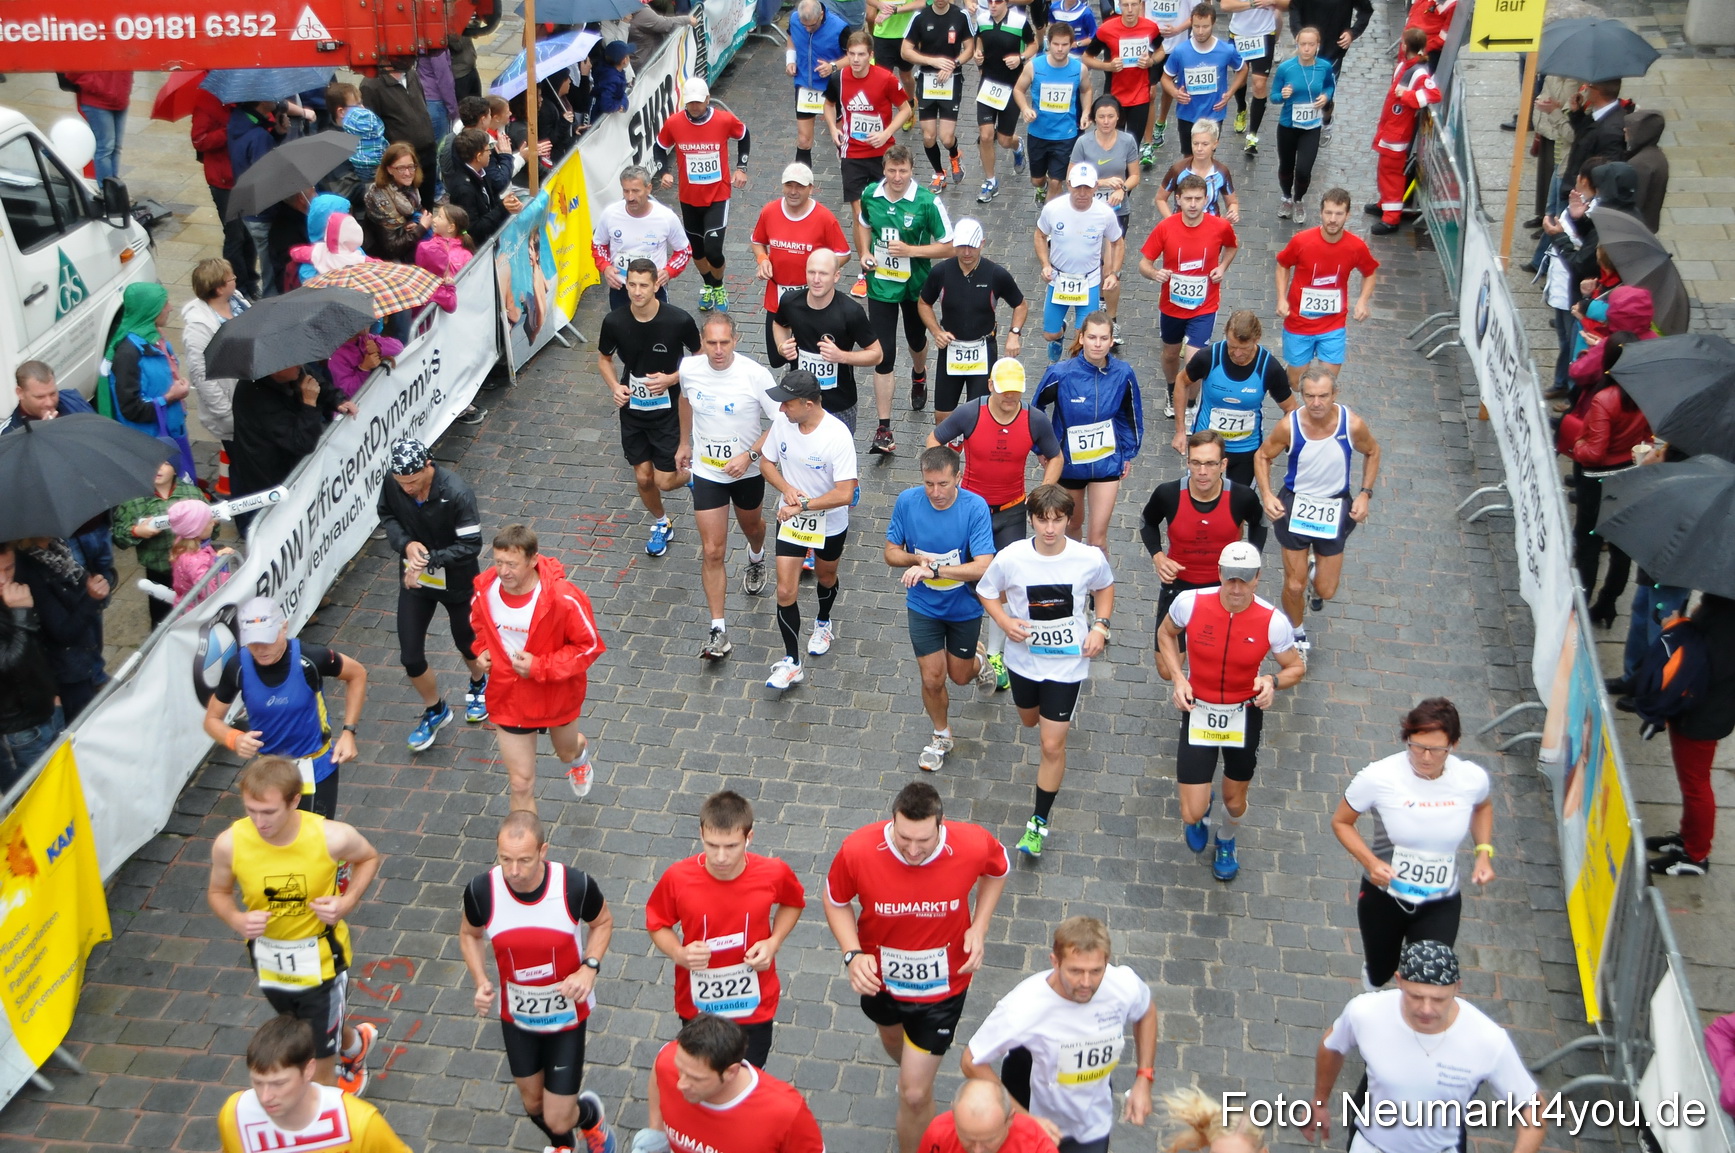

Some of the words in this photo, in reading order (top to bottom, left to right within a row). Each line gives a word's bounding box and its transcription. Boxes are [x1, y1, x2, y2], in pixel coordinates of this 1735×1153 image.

[1154, 1, 1175, 12] 2461
[115, 16, 196, 40] 09181
[206, 15, 276, 37] 6352
[1238, 39, 1260, 52] 2641
[1188, 73, 1214, 84] 2430
[808, 92, 819, 102] 21
[990, 86, 1002, 98] 80
[1047, 92, 1066, 102] 137
[854, 120, 881, 132] 2075
[690, 160, 718, 174] 2380
[770, 239, 806, 250] NEUMARKT
[884, 256, 900, 270] 46
[886, 270, 899, 278] Horst
[1060, 281, 1082, 293] 191
[1172, 282, 1204, 297] 2332
[1304, 297, 1336, 312] 2331
[956, 349, 980, 362] 540
[802, 360, 835, 377] 3039
[1218, 417, 1245, 431] 271
[307, 348, 441, 542] EfficientDynamics
[1078, 432, 1104, 450] 577
[706, 444, 732, 458] 178
[1296, 503, 1336, 523] 2218
[792, 531, 813, 542] Werner
[1032, 628, 1074, 646] 2993
[1208, 712, 1228, 729] 60
[1202, 730, 1230, 740] Thomas
[1398, 861, 1448, 884] 2950
[874, 901, 946, 914] NEUMARKT
[274, 952, 296, 972] 11
[888, 960, 940, 980] 2381
[698, 976, 753, 1000] 2322
[514, 994, 568, 1014] 2273
[705, 1001, 749, 1013] Alexander
[1074, 1044, 1113, 1069] 168
[1076, 1069, 1105, 1082] Rudolf
